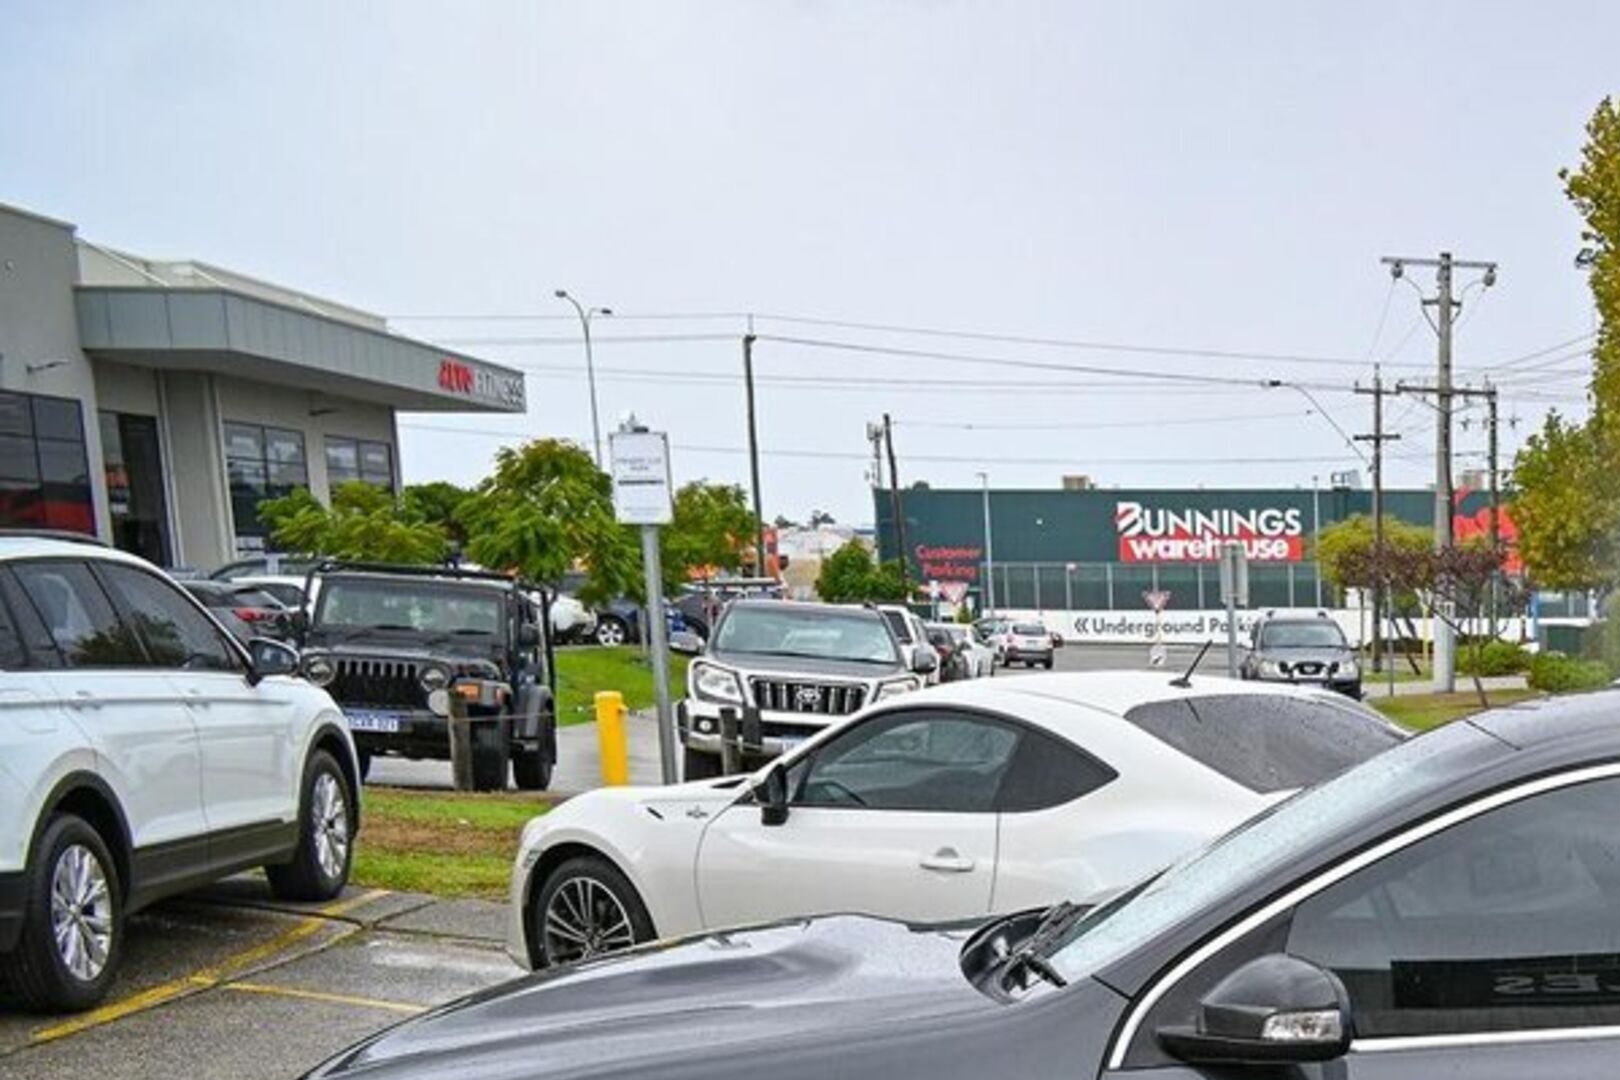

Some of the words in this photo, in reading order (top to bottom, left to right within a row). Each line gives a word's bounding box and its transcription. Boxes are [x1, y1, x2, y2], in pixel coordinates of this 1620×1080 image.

[1115, 502, 1302, 536] BUNNINGS
[915, 544, 981, 560] Customer
[922, 562, 977, 580] Parking
[1092, 617, 1204, 637] Underground
